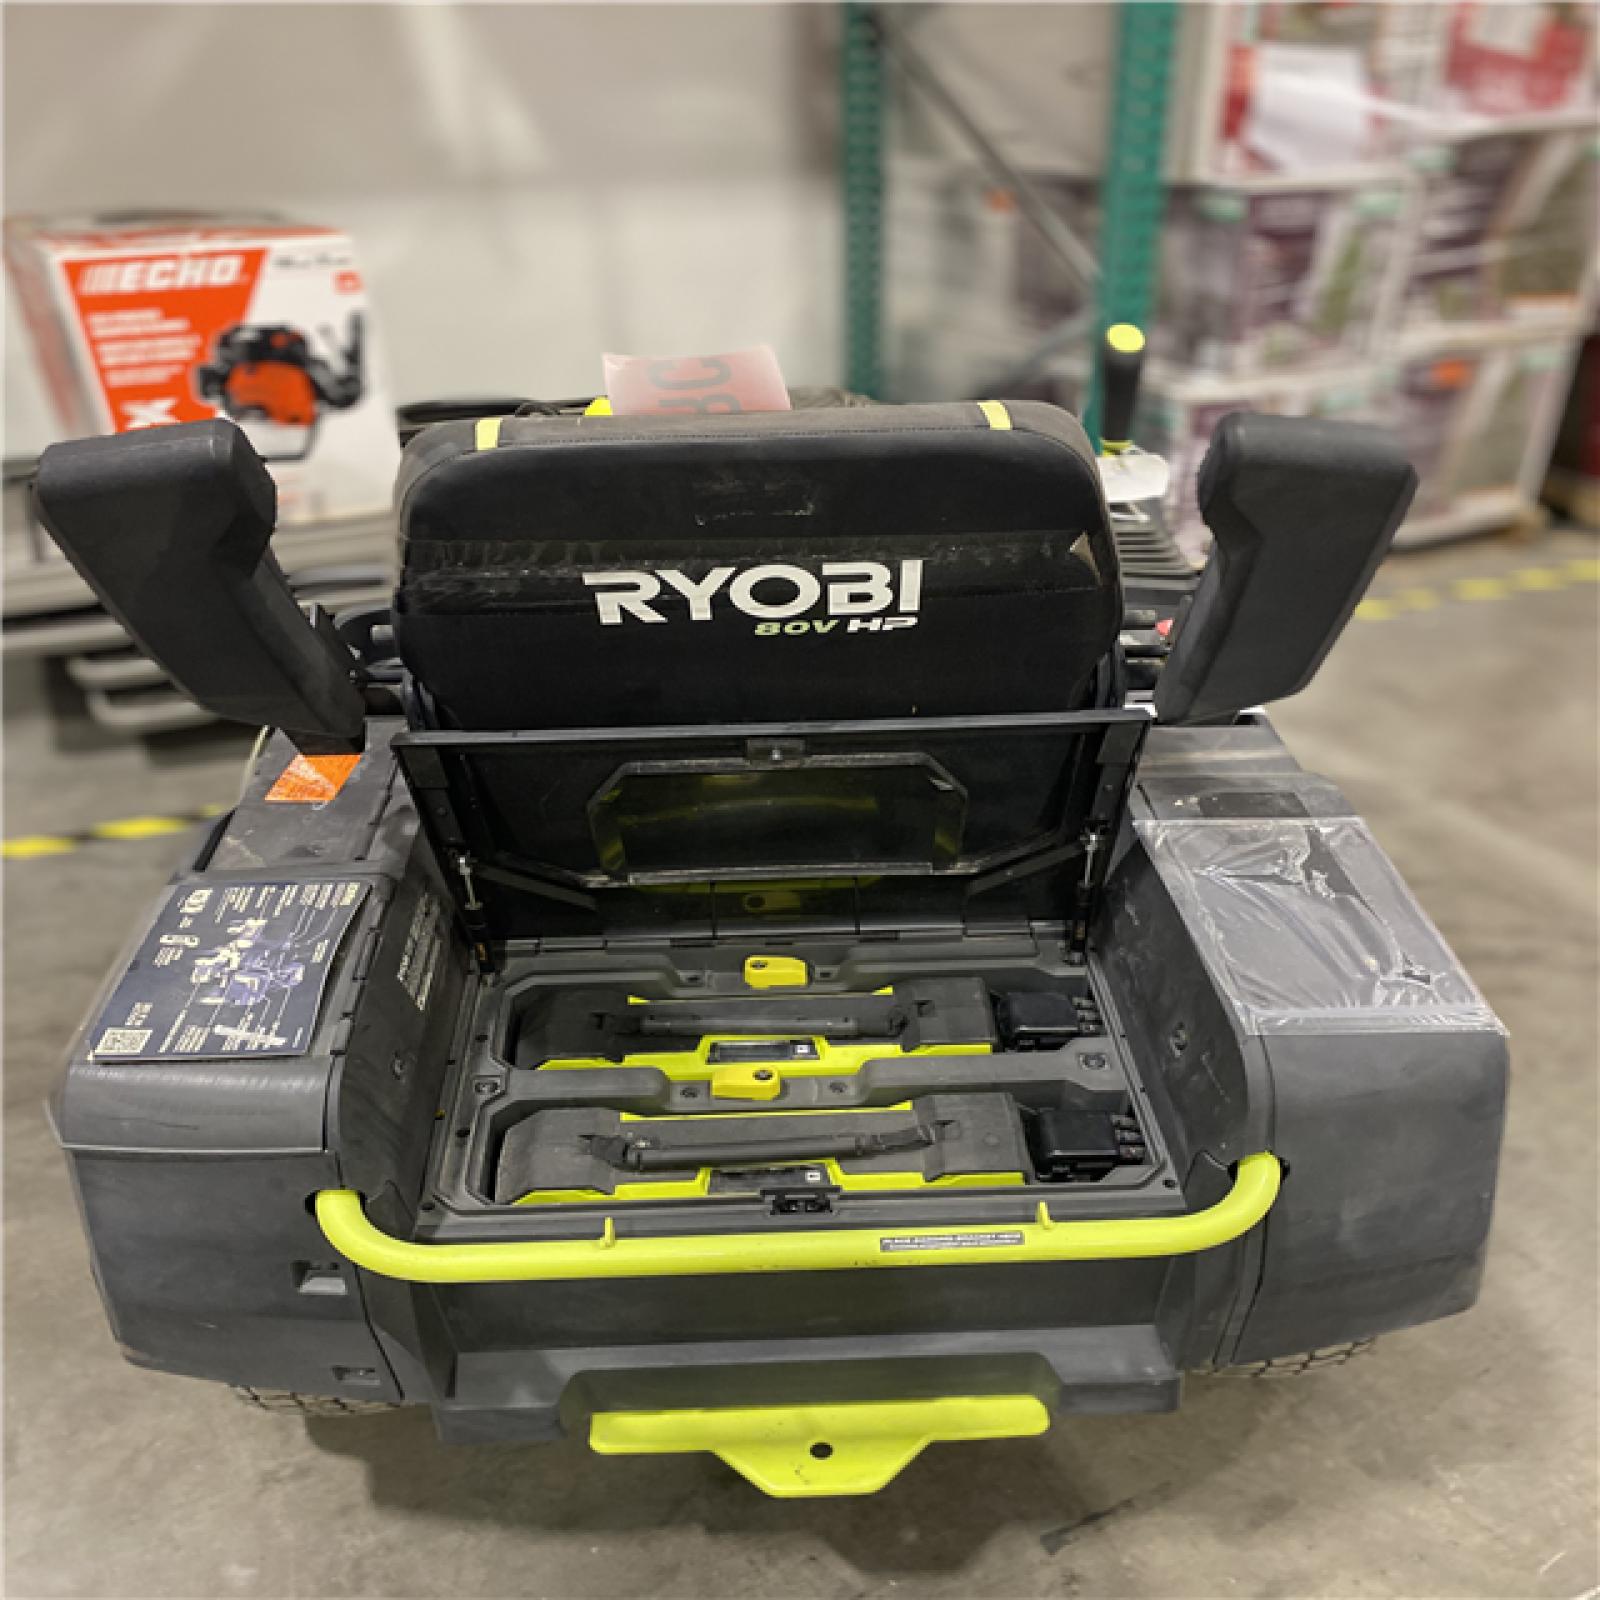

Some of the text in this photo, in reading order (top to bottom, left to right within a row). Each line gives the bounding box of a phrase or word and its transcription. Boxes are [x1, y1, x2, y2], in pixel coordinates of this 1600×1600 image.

[583, 559, 923, 625] RYOBI
[754, 616, 918, 636] 80V HP
